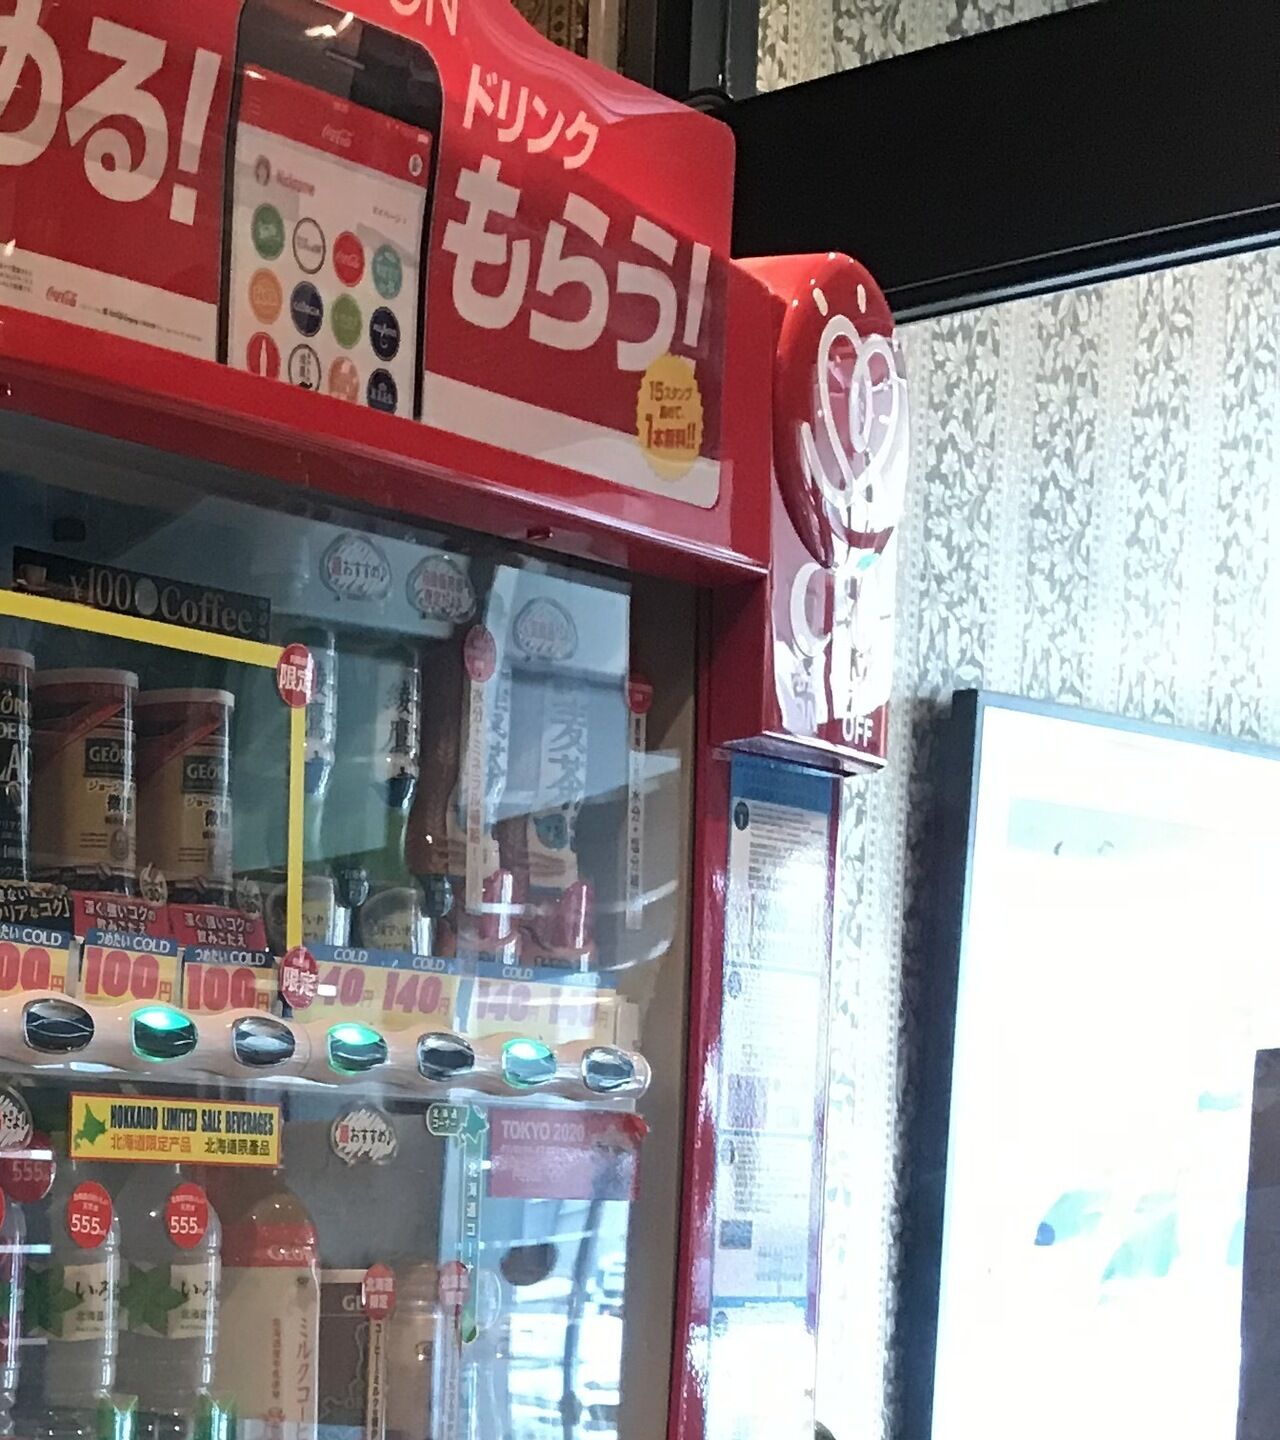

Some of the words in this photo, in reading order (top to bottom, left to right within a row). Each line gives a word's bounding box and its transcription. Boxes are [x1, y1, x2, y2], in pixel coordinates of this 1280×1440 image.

[463, 65, 599, 169] ドリンク
[446, 154, 711, 370] もらう!
[161, 581, 253, 635] Coffee
[843, 715, 873, 747] OFF
[22, 928, 62, 945] COLD
[96, 931, 130, 946] つめたい
[133, 935, 170, 952] COLD
[195, 949, 228, 963] つめたい
[230, 950, 265, 966] COLD
[334, 949, 368, 963] COLD
[412, 957, 445, 971] COLD
[502, 966, 533, 979] COLD
[111, 1104, 158, 1130] HOKKAIDO
[162, 1107, 197, 1131] LIMITED
[202, 1109, 221, 1133] SALE
[225, 1110, 273, 1136] BEVERAGES
[502, 1121, 550, 1140] TOKYO
[554, 1124, 585, 1142] 2020
